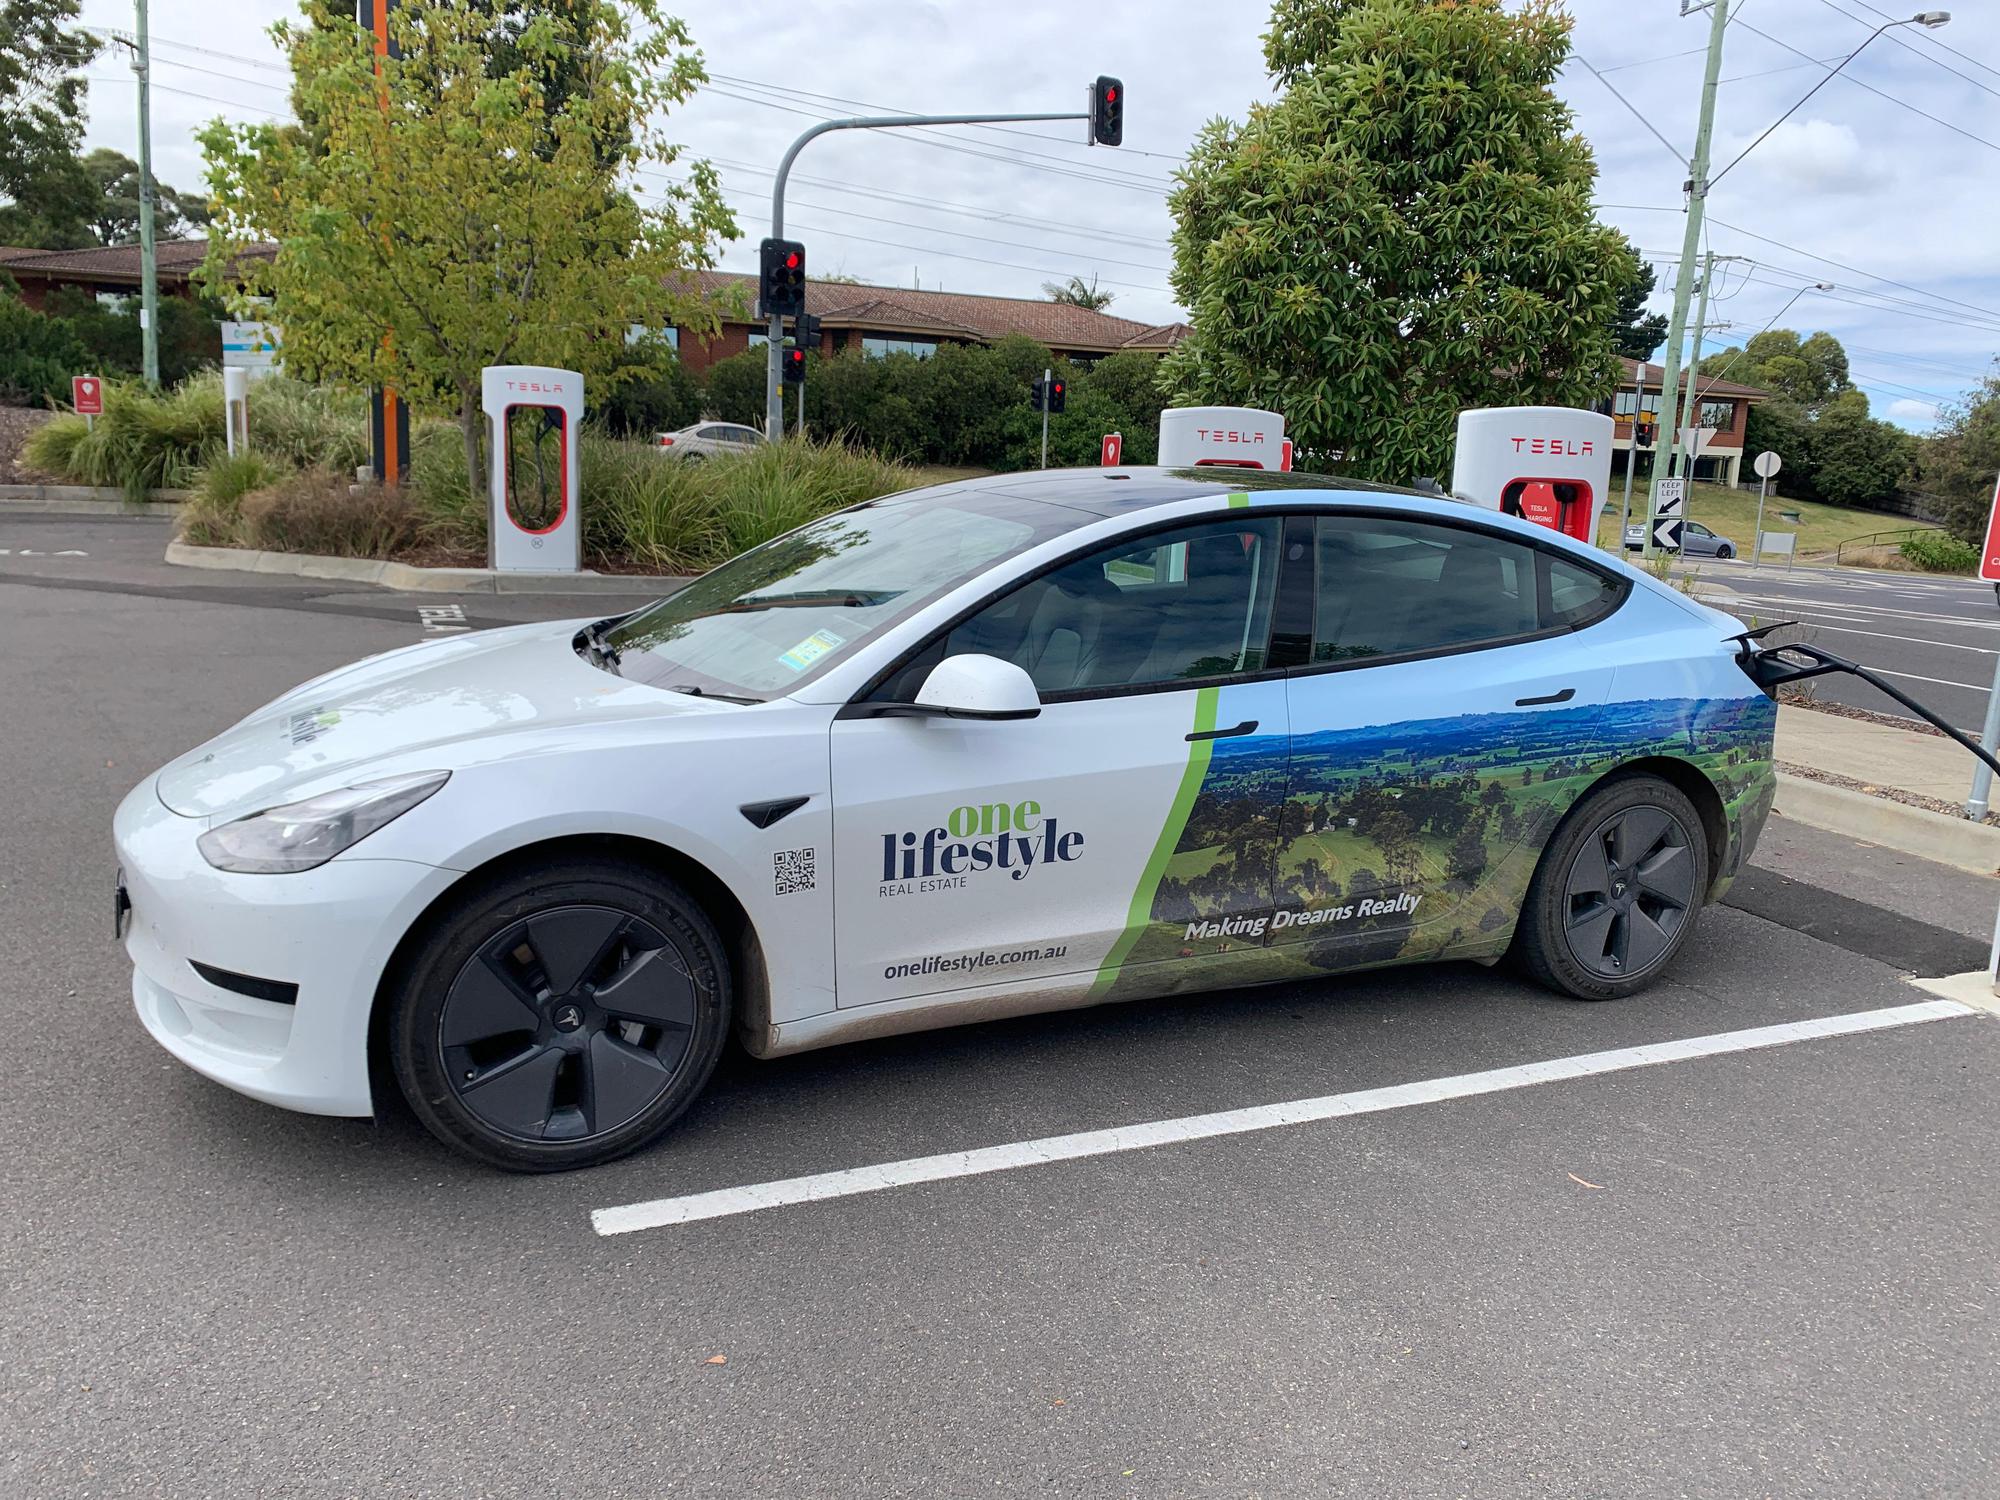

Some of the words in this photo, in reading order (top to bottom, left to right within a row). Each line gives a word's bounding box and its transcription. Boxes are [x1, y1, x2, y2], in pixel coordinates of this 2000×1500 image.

[505, 381, 563, 393] TESLA
[1197, 430, 1264, 444] TESLA
[1511, 438, 1593, 456] TESLA
[1661, 489, 1680, 497] LEFT
[1530, 504, 1548, 512] TESLA
[948, 800, 1041, 838] one
[880, 817, 1085, 881] lifestyle
[879, 882, 914, 898] REAL
[920, 876, 968, 893] ESTATE
[1183, 915, 1270, 941] Making
[1271, 903, 1355, 930] Dreams
[1357, 892, 1424, 918] Realty
[884, 945, 1067, 980] onelifestyle.com.au
